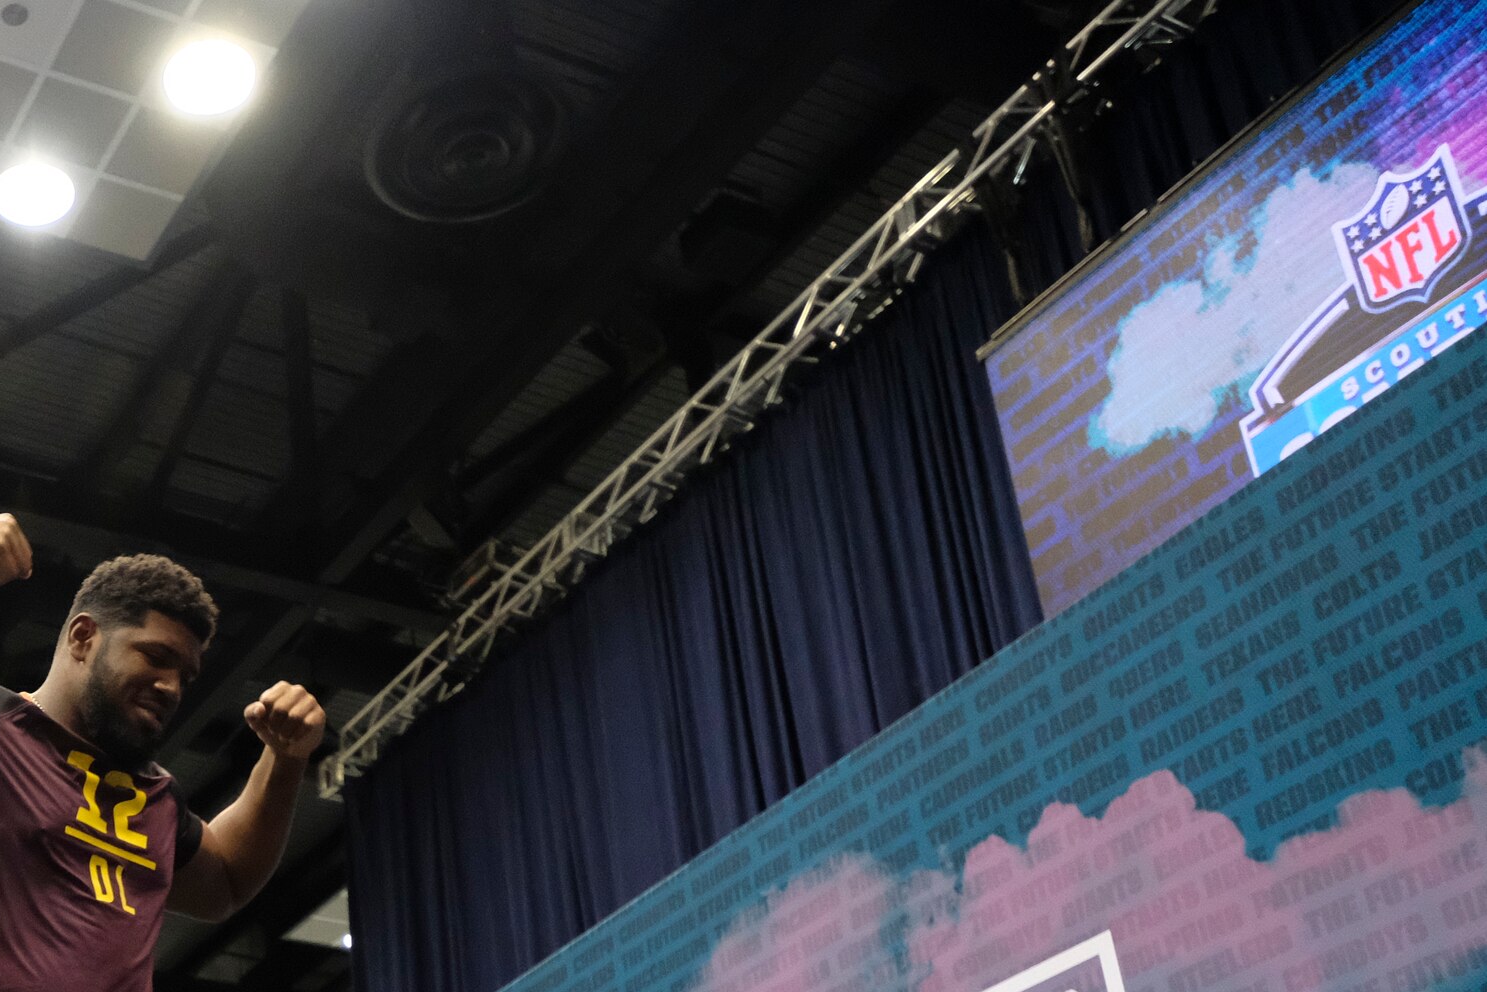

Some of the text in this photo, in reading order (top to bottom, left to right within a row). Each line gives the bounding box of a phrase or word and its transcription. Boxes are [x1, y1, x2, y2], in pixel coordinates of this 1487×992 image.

[1362, 209, 1459, 299] NFL
[690, 842, 751, 898] RAIDERS
[757, 818, 786, 855] THE
[788, 777, 849, 834] FUTURE
[850, 733, 916, 794] STARTS
[918, 701, 966, 750] HERE
[973, 630, 1074, 715] COWBOYS
[1080, 569, 1166, 644] GIANTS
[1173, 502, 1266, 583] EAGLES
[1274, 403, 1417, 517] REDSKINS
[697, 873, 752, 925] STARTS
[753, 847, 791, 889] HERE
[797, 798, 870, 861] FALCONS
[875, 734, 970, 812] PANTHERS
[977, 682, 1052, 748] SAINTS
[1059, 582, 1208, 696] BUCCANEERS
[1215, 544, 1268, 597] THE
[1268, 475, 1375, 563] FUTURE
[867, 806, 912, 852] HERE
[918, 736, 1026, 821] CARDINALS
[1032, 691, 1099, 751] RAMS
[1106, 638, 1185, 706] 49ERS
[1193, 541, 1340, 652] SEAHAWKS
[1349, 498, 1410, 556] THE
[927, 811, 962, 851] THE
[963, 765, 1041, 830] FUTURE
[1042, 713, 1127, 784] STARTS
[1129, 675, 1192, 732] HERE
[1200, 608, 1303, 690] TEXANS
[1310, 548, 1403, 624] COLTS
[1139, 684, 1247, 767] RAIDERS
[1255, 648, 1310, 700] THE
[1311, 582, 1424, 668] FUTURE
[1251, 605, 1466, 746] HERE FALCONS
[67, 750, 147, 849] 12
[1185, 767, 1252, 824] HERE
[1260, 695, 1386, 785] FALCONS
[1254, 737, 1396, 832] REDSKINS
[1407, 697, 1472, 754] THE
